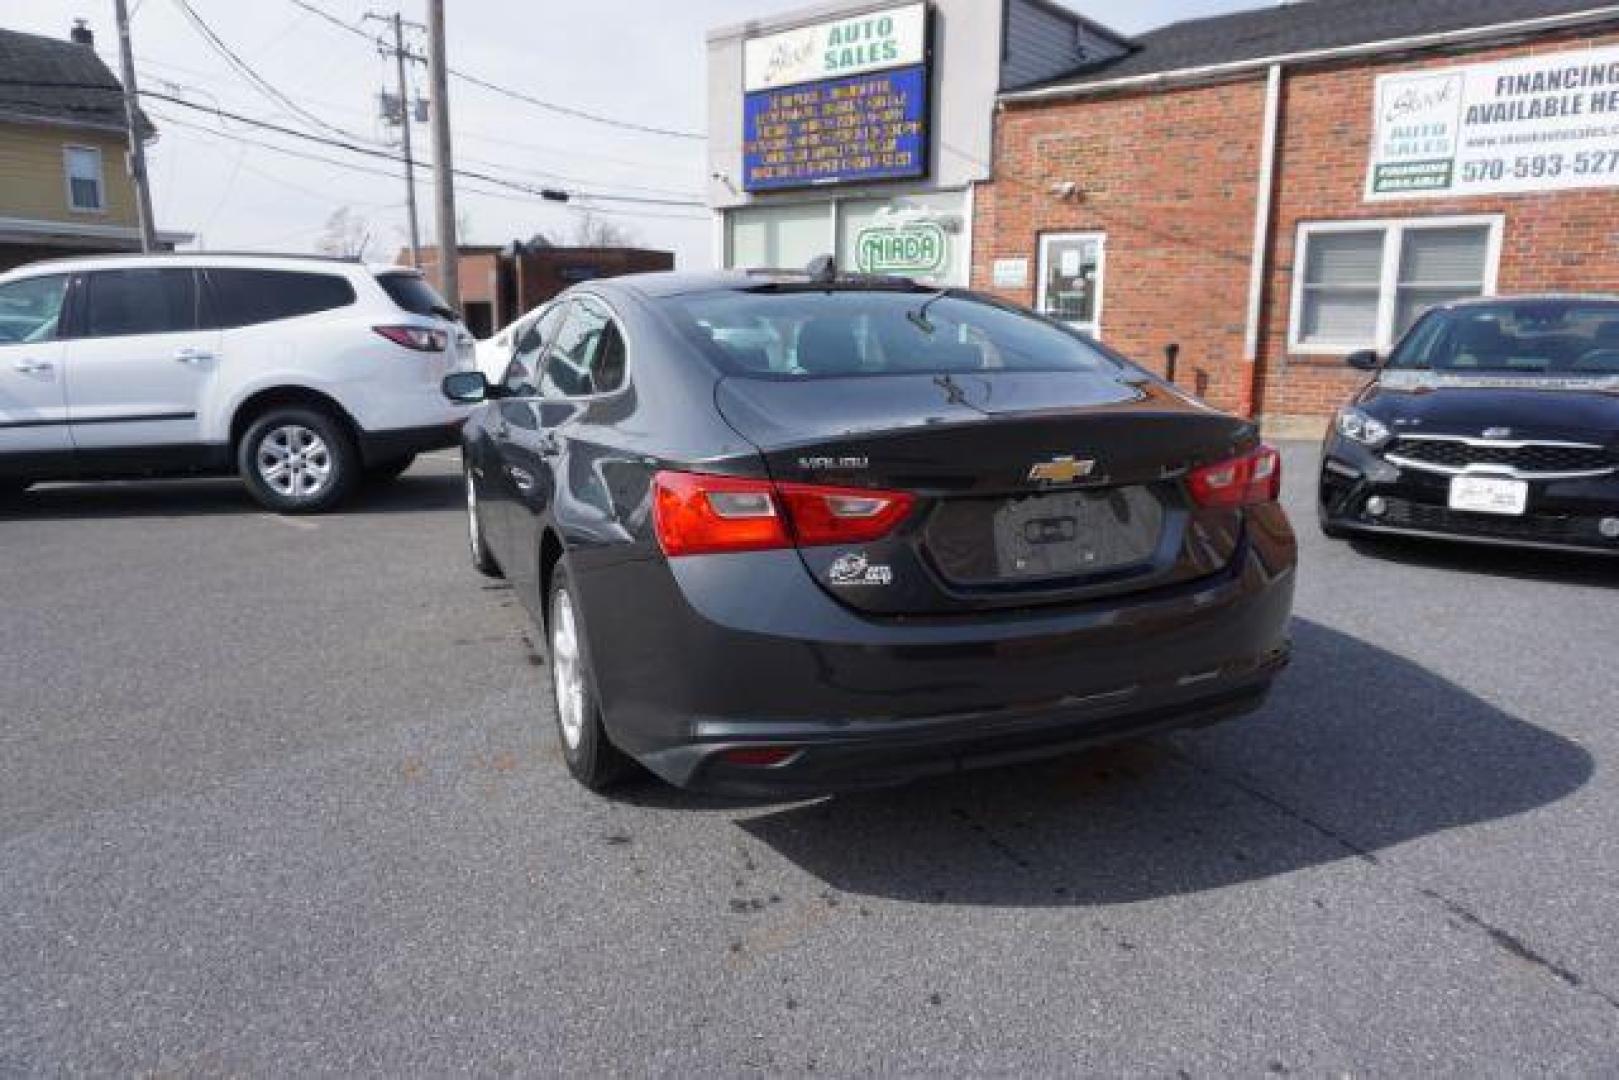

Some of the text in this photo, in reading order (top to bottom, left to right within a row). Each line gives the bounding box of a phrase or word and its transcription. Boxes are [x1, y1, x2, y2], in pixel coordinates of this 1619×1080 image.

[828, 16, 895, 46] AUTO
[824, 40, 898, 70] SALES
[1496, 62, 1619, 96] FINANCING
[1465, 93, 1585, 125] AVAILABLE
